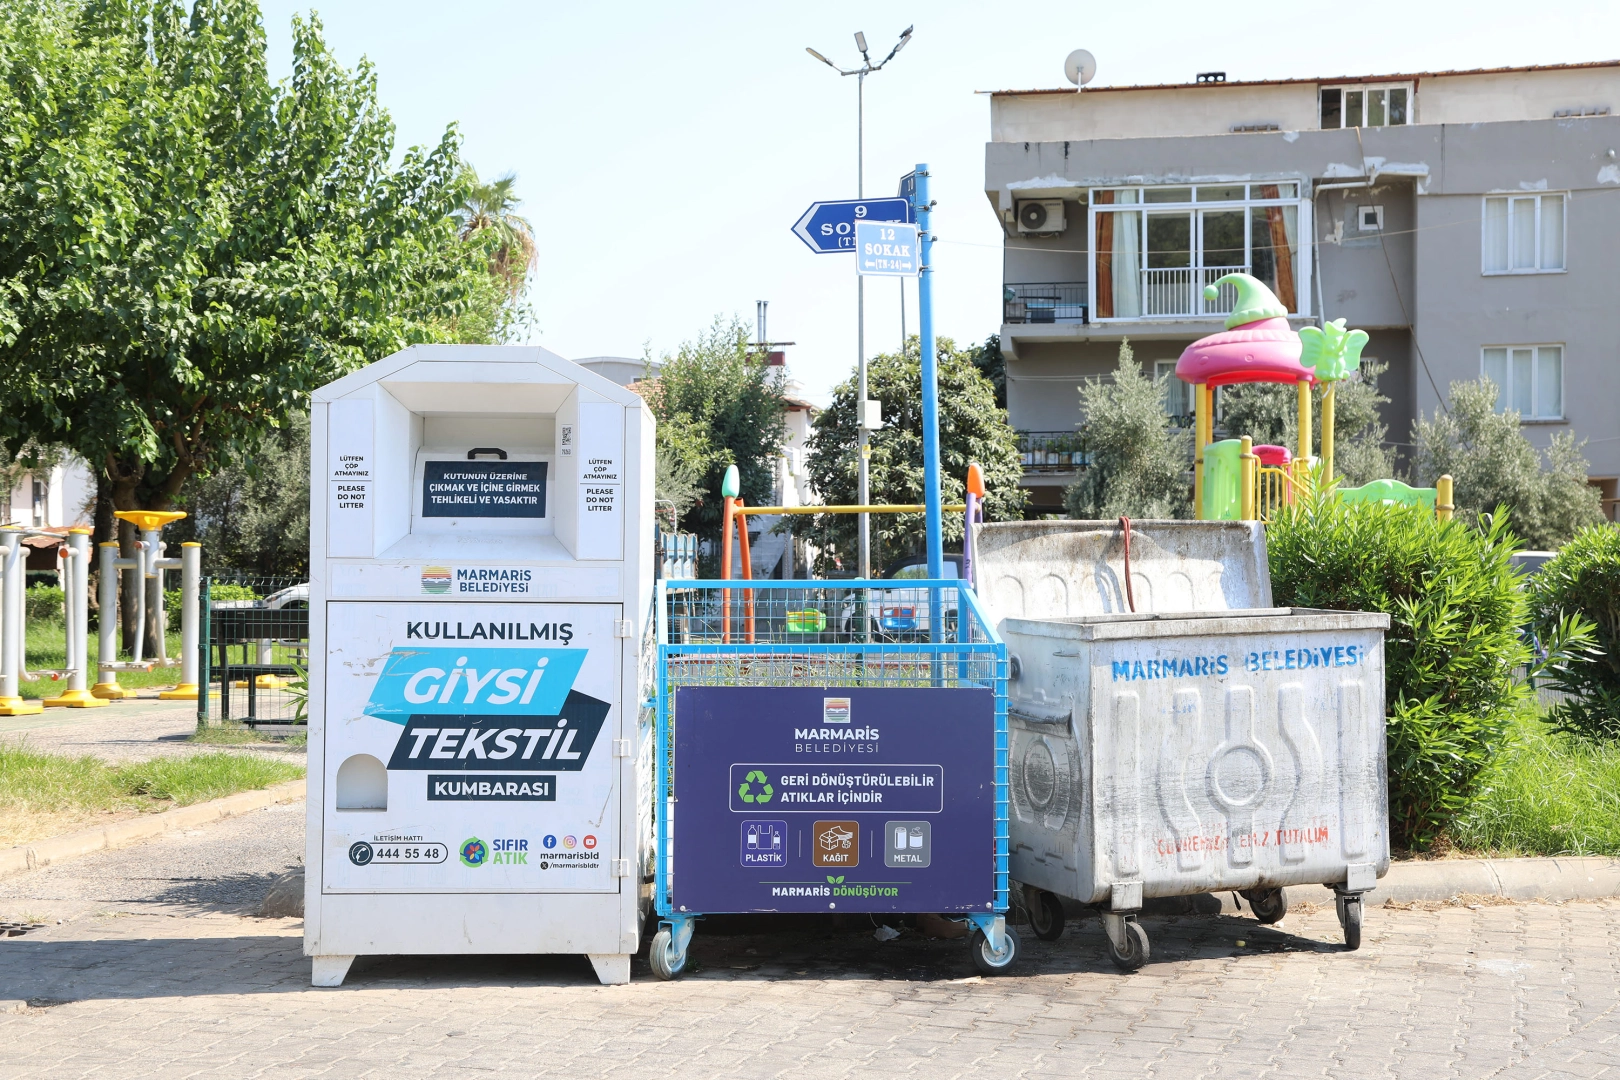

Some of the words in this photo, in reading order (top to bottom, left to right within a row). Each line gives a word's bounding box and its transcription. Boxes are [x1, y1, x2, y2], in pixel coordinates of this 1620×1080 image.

[855, 205, 868, 218] 9
[880, 228, 895, 240] 12
[865, 243, 911, 257] SOKAK
[875, 258, 902, 271] (TN-24)
[339, 455, 364, 463] LÜTFEN
[588, 458, 613, 466] LÜTFEN
[344, 462, 359, 470] ÇÖP
[489, 471, 528, 480] ÜZERİNE
[429, 483, 465, 494] ÇIKMAK
[466, 483, 479, 492] VE
[480, 482, 505, 494] İÇİNE
[507, 481, 540, 493] GİRMEK
[431, 493, 477, 504] TEHLİKELİ
[478, 495, 491, 504] VE
[492, 495, 538, 505] YASAKTIR
[407, 622, 573, 645] KULLANILMIŞ
[404, 656, 549, 705] GİYSİ
[409, 719, 581, 759] TEKSTİL
[794, 725, 880, 741] MARMARİS
[795, 741, 879, 753] BELEDİYESİ
[780, 772, 809, 786] GERİ
[812, 772, 934, 789] DÖNÜŞTÜRÜLEBİLİR
[434, 781, 549, 796] KUMBARASI
[780, 792, 835, 803] ATIKLAR
[837, 789, 883, 805] İÇİNDİR
[373, 834, 402, 842] İLETİŞİM
[492, 838, 529, 851] SIFIR
[376, 848, 400, 859] 444
[404, 848, 420, 859] 55
[423, 848, 439, 859] 48
[492, 851, 528, 865] ATIK
[540, 851, 600, 860] marmarisbld
[745, 852, 782, 862] PLASTİK
[822, 852, 849, 862] KAĞIT
[893, 854, 923, 863] METAL
[772, 884, 831, 897] MARMARİS
[833, 884, 899, 899] DÖNÜŞÜYOR
